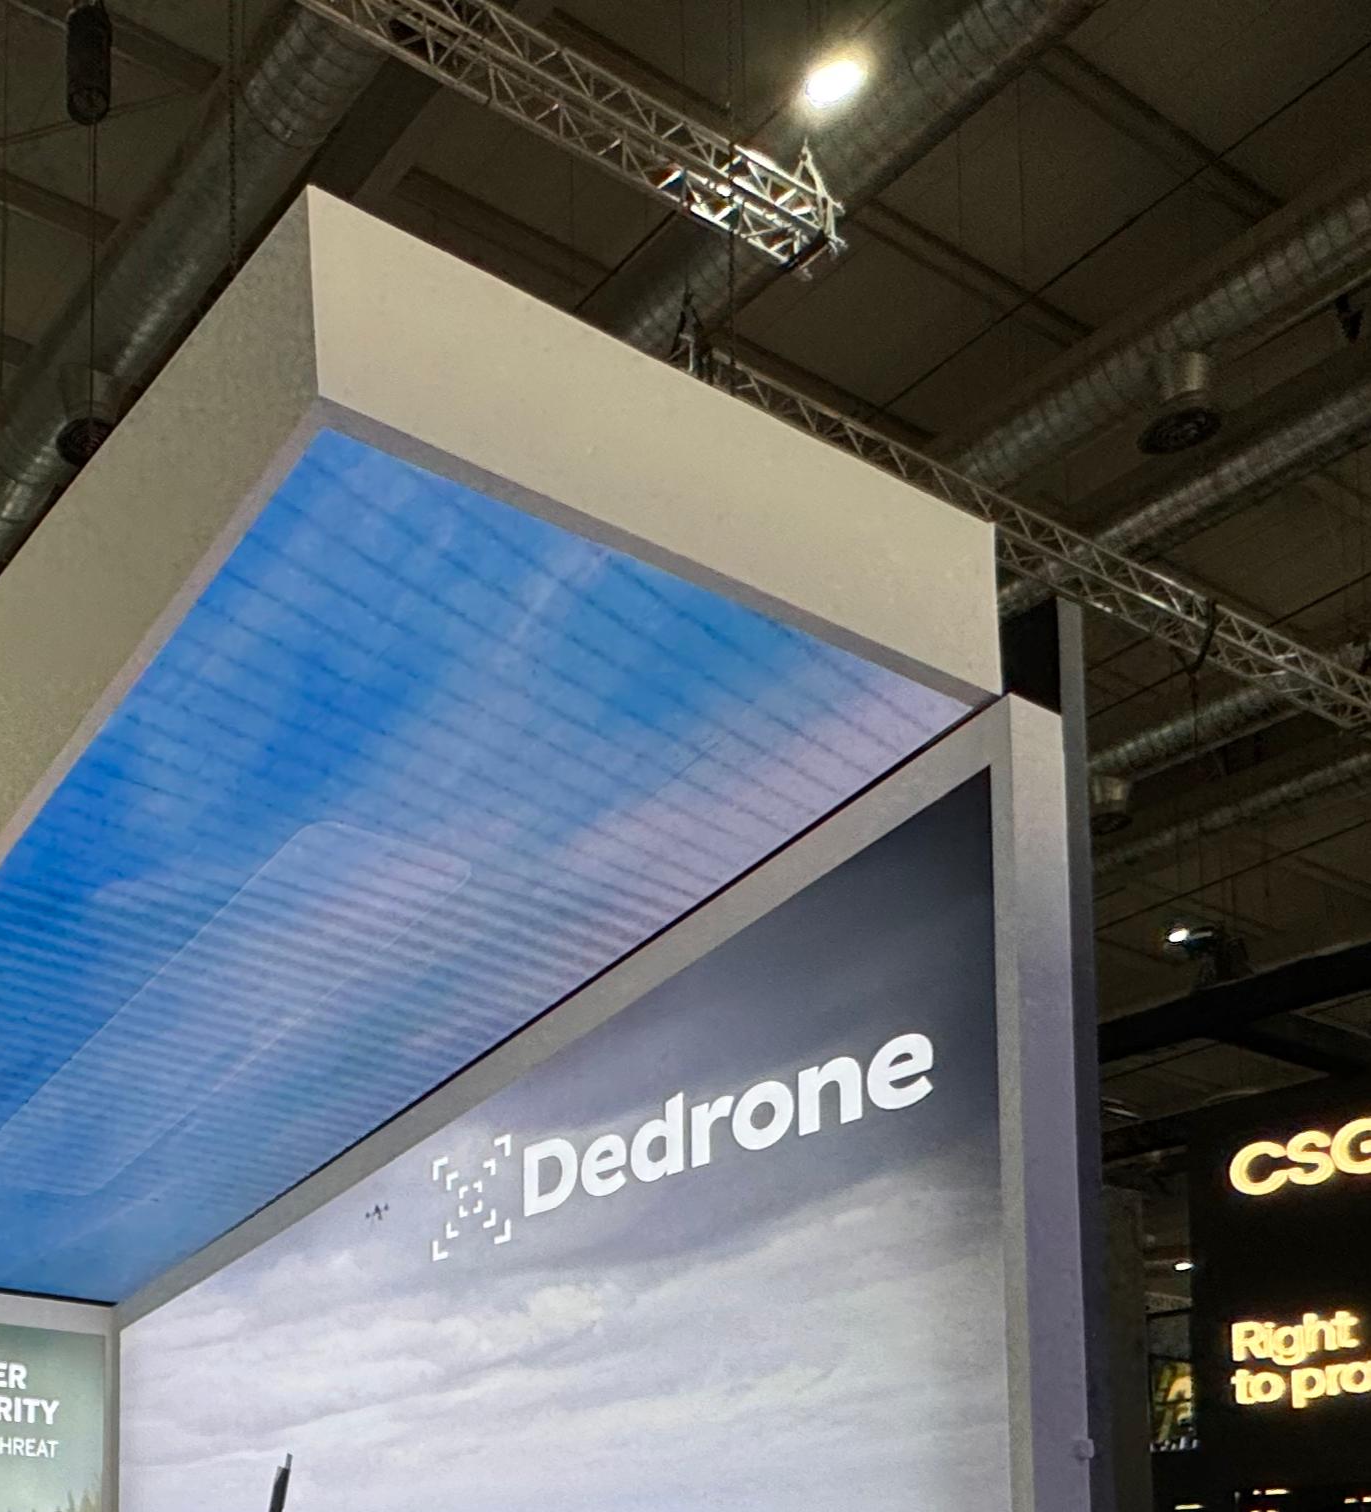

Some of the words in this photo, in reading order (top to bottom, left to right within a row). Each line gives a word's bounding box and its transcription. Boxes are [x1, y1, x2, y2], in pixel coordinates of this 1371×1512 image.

[523, 1032, 934, 1217] Dedrone
[1229, 1117, 1371, 1195] CSG
[1231, 1310, 1361, 1367] Right
[1230, 1368, 1287, 1406] to
